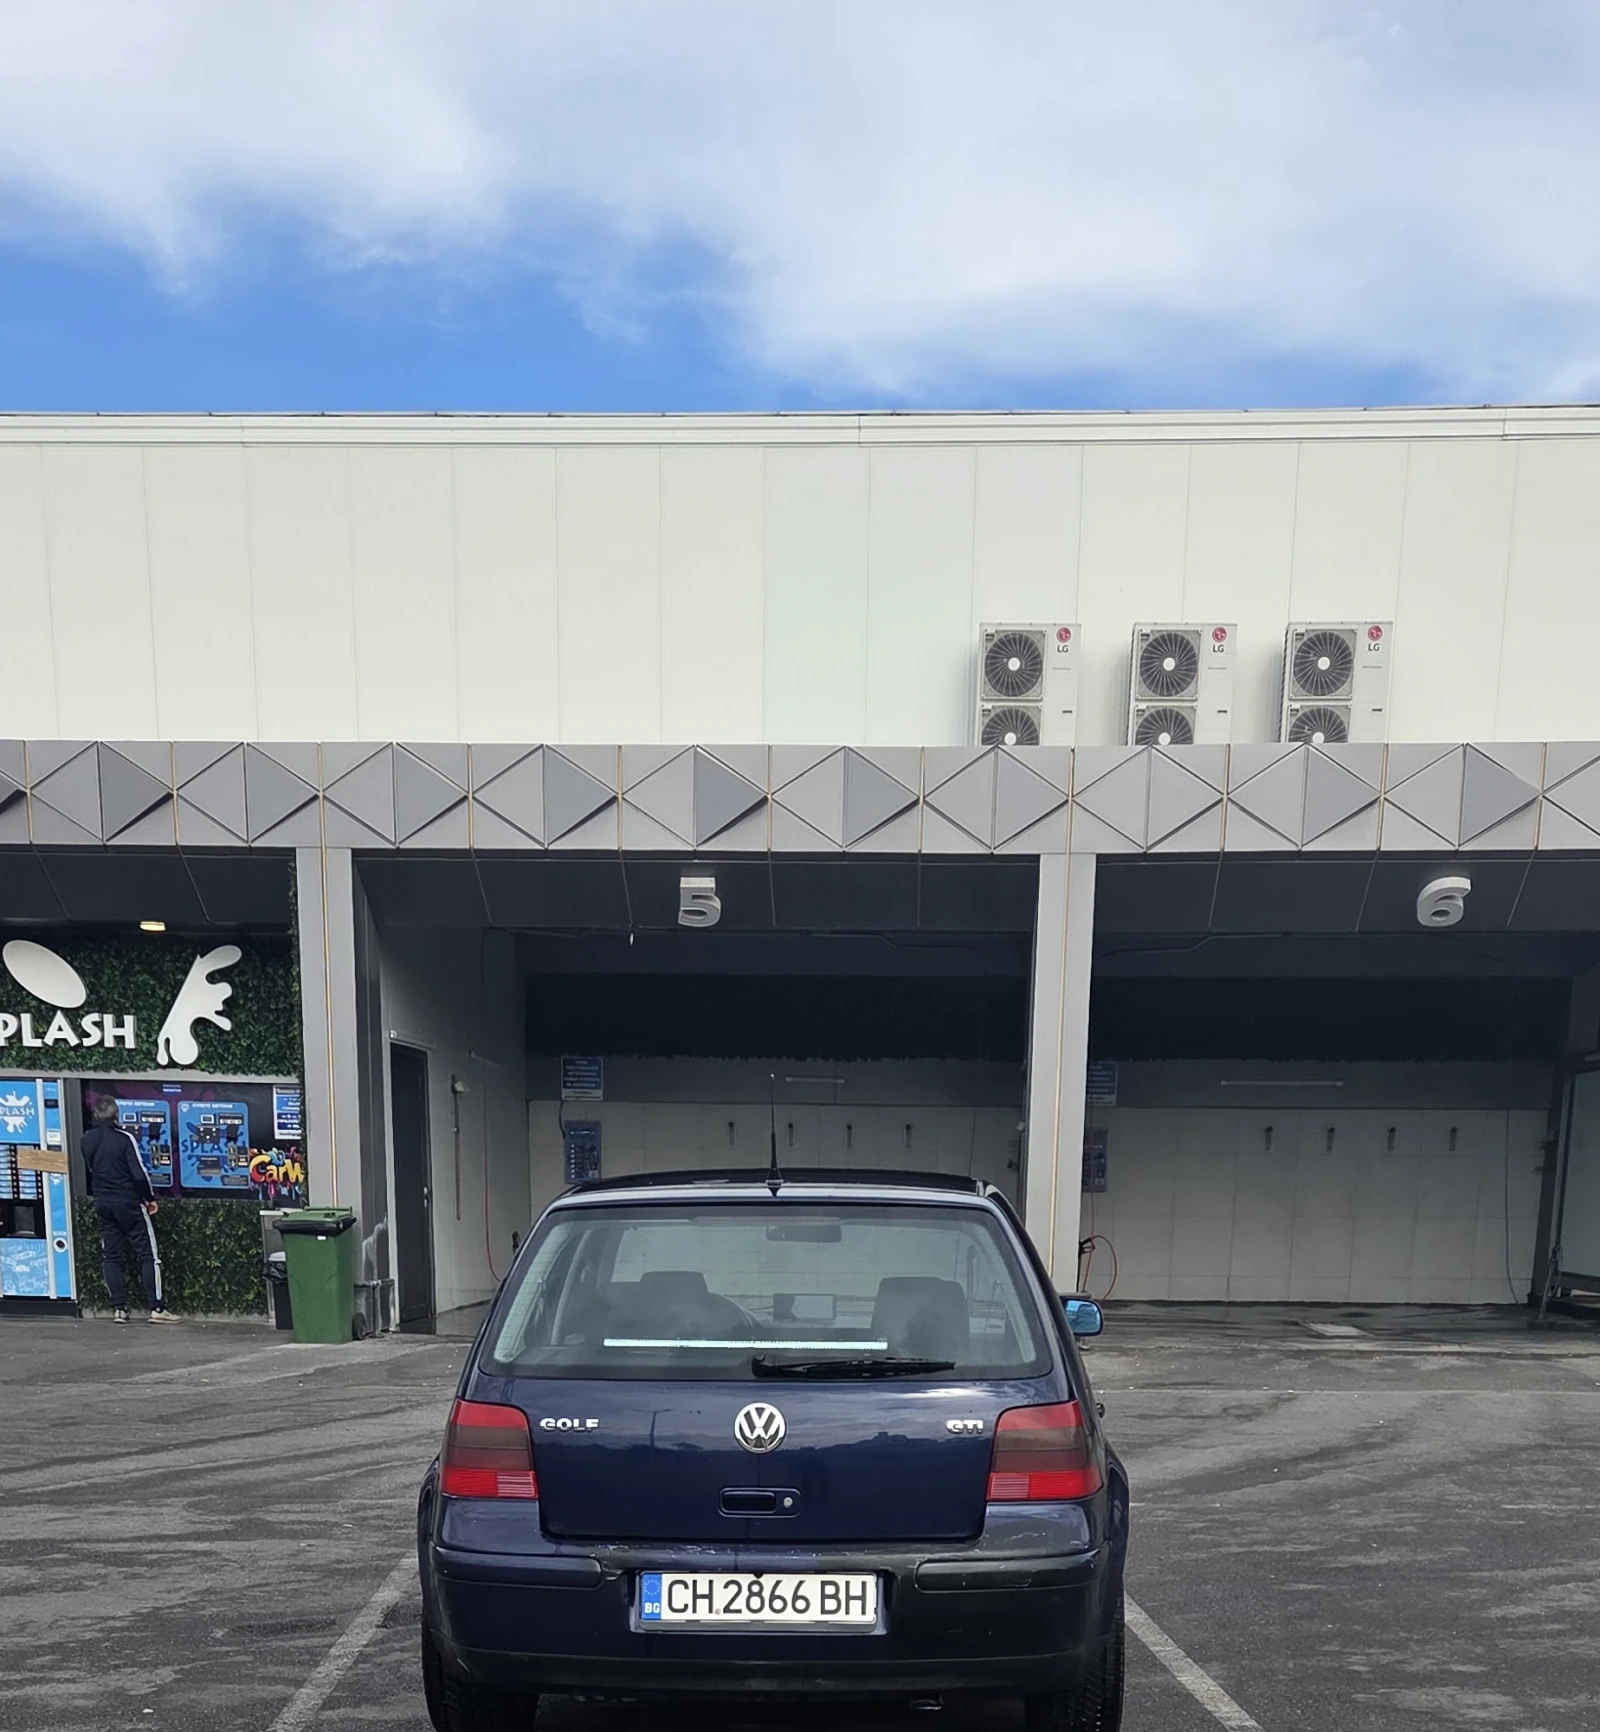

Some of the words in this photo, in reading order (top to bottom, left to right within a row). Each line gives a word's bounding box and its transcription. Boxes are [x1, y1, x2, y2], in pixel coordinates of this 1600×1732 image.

[1057, 644, 1069, 653] LG
[1212, 644, 1225, 653] LG
[1367, 643, 1380, 652] LG
[678, 876, 721, 928] 5
[1416, 876, 1471, 927] 6
[539, 1417, 599, 1432] GOLF
[946, 1419, 984, 1434] GTI
[722, 1579, 811, 1615] 2866
[820, 1580, 868, 1616] BH
[644, 1603, 660, 1614] BG
